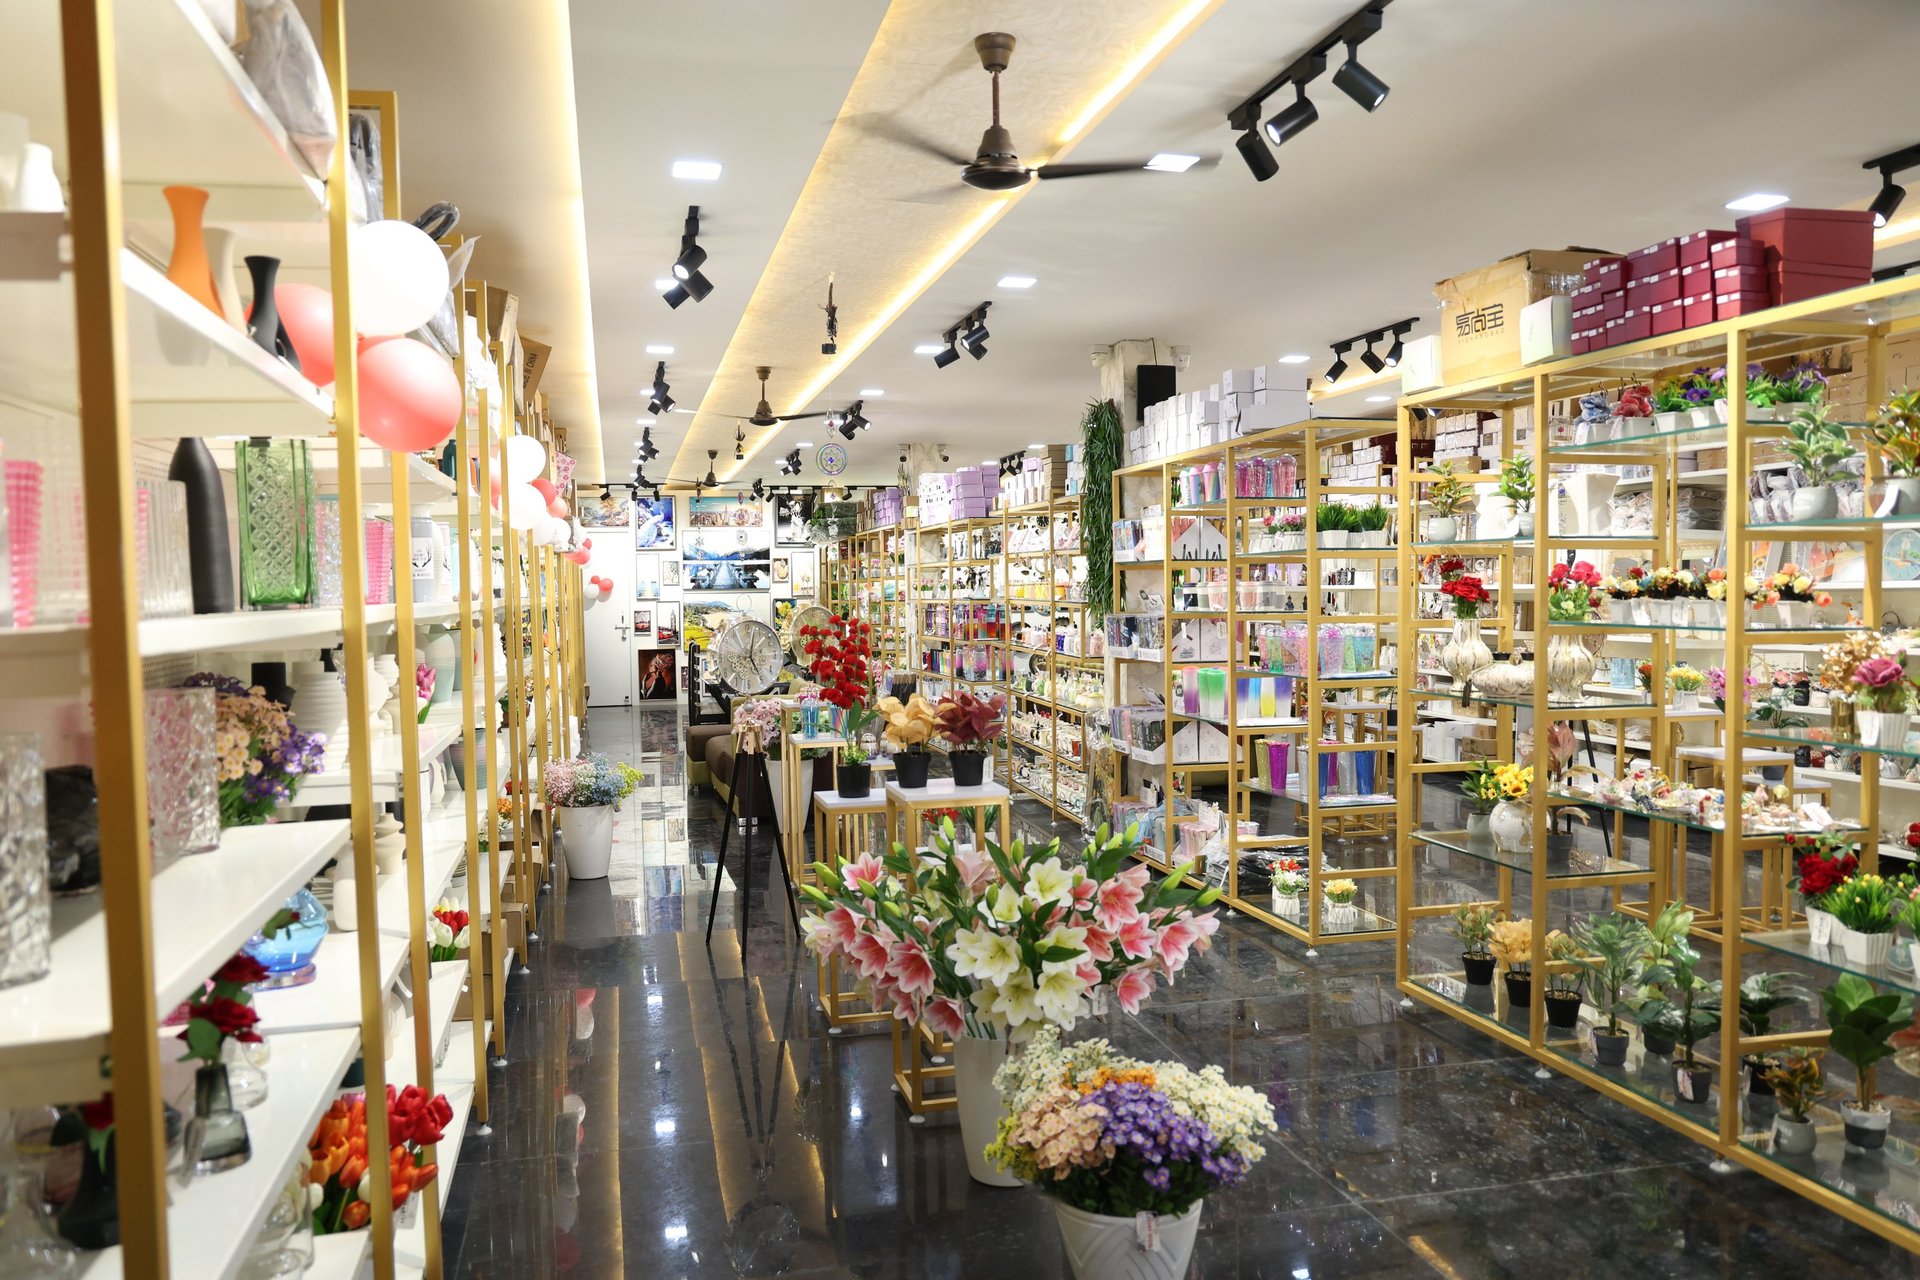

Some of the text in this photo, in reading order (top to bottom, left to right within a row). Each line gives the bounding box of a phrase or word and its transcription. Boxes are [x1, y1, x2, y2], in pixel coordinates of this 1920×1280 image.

[1455, 303, 1504, 337] 易尚宝
[526, 352, 538, 368] CHINA
